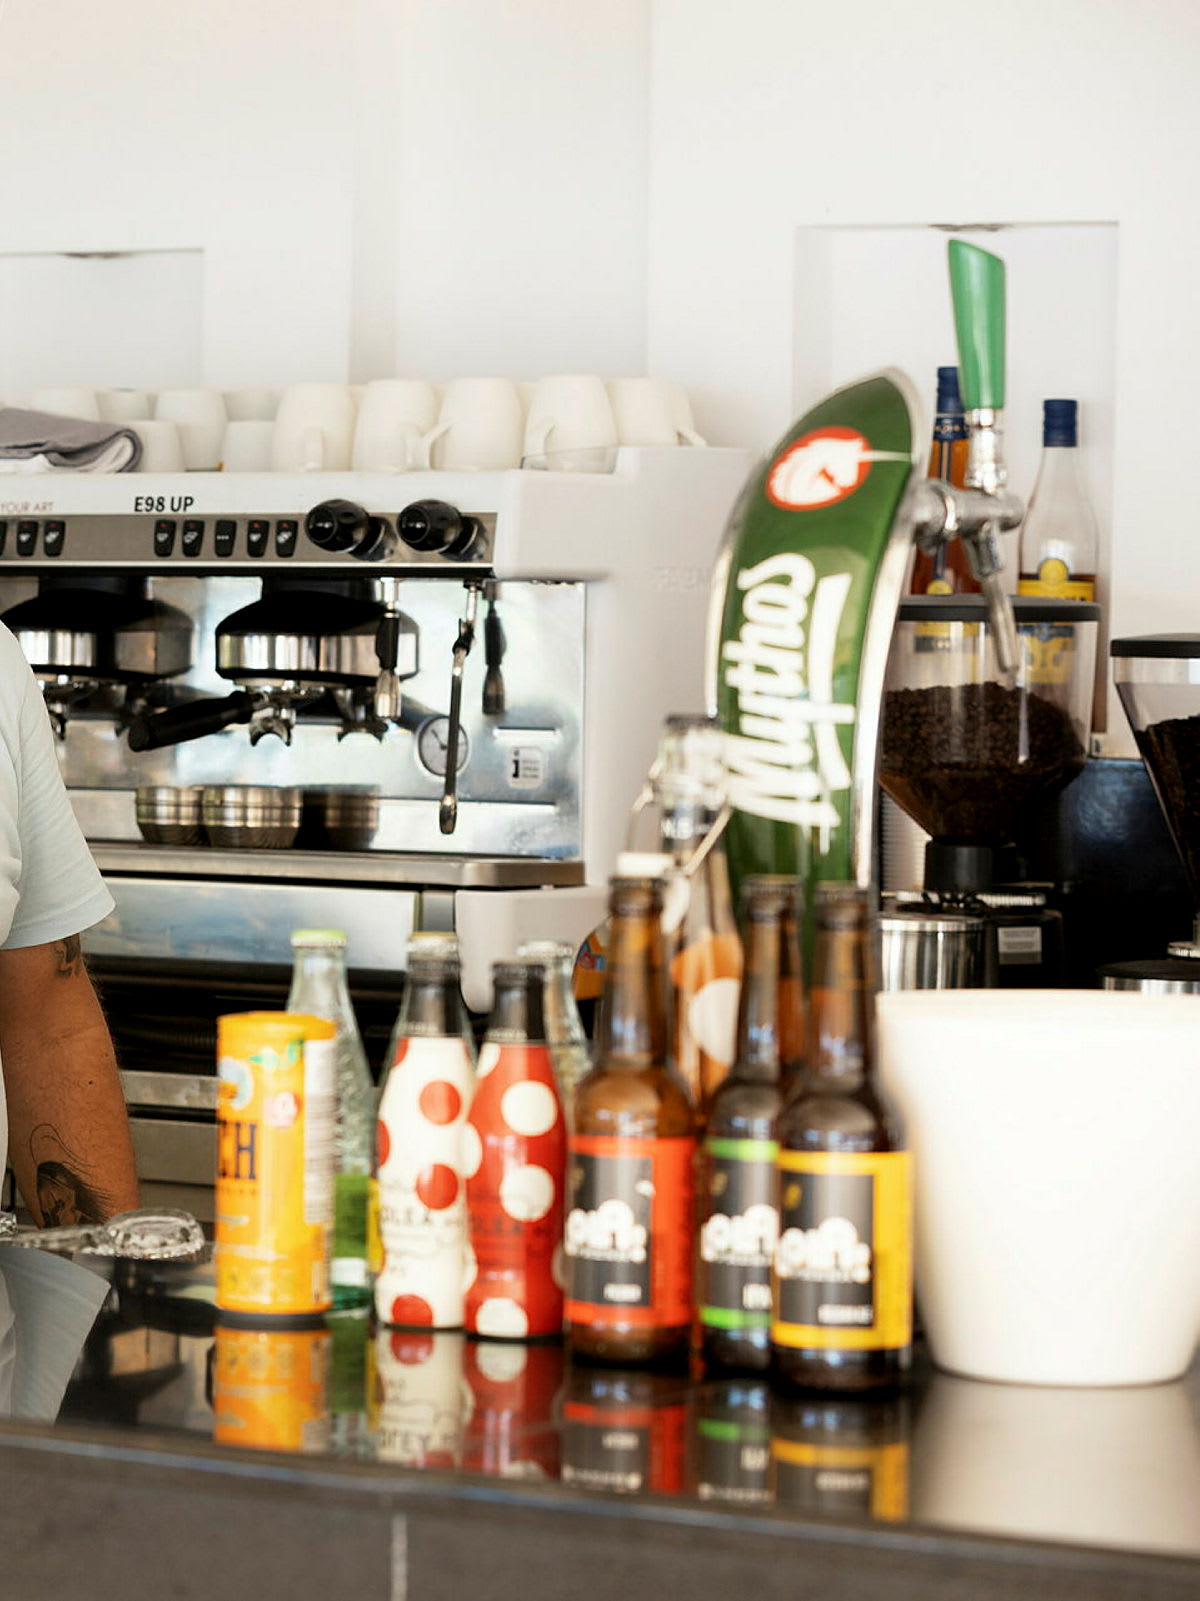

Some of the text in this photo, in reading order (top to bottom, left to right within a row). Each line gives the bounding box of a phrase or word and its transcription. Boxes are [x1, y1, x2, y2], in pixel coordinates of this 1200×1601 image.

[0, 501, 30, 513] YOUR
[33, 501, 54, 512] ART
[134, 496, 195, 513] E98 UP
